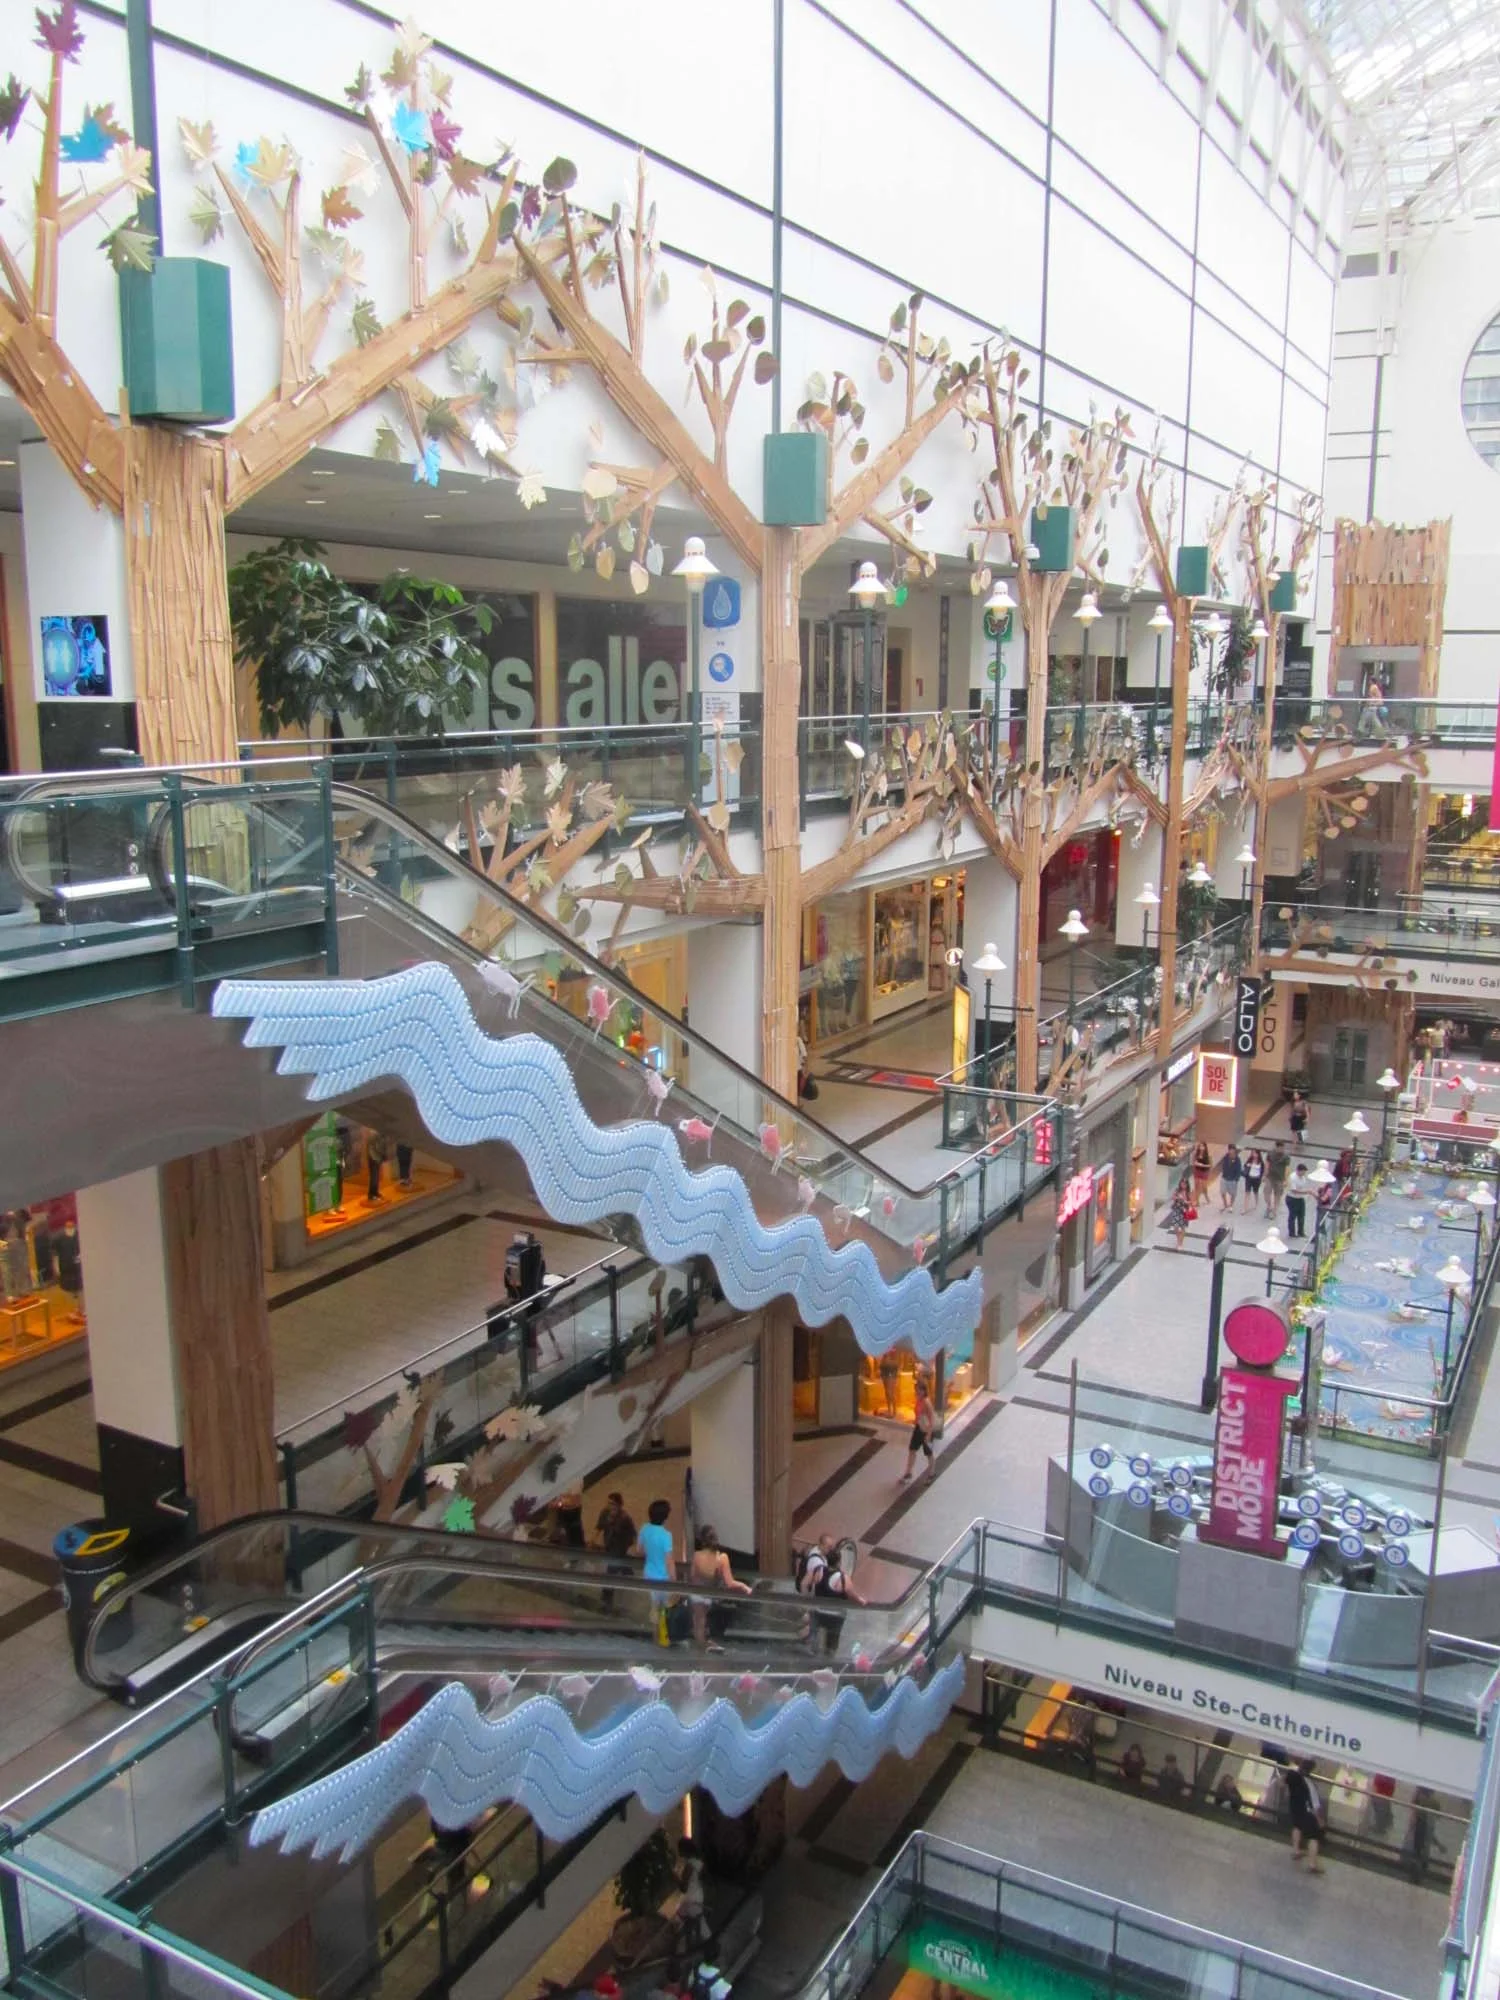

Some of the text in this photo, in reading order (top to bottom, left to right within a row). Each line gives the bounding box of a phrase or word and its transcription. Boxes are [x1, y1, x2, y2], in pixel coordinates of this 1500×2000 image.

[1430, 973, 1475, 986] Niveau
[1238, 983, 1255, 1053] ALDO
[1206, 1065, 1229, 1080] SOL
[1208, 1080, 1225, 1093] DE
[1215, 1376, 1248, 1512] DISTRICT
[1236, 1457, 1266, 1541] MODE
[1103, 1663, 1184, 1702] Niveau
[1191, 1689, 1363, 1753] Ste-Catherine
[925, 1943, 988, 1980] CENTRAL
